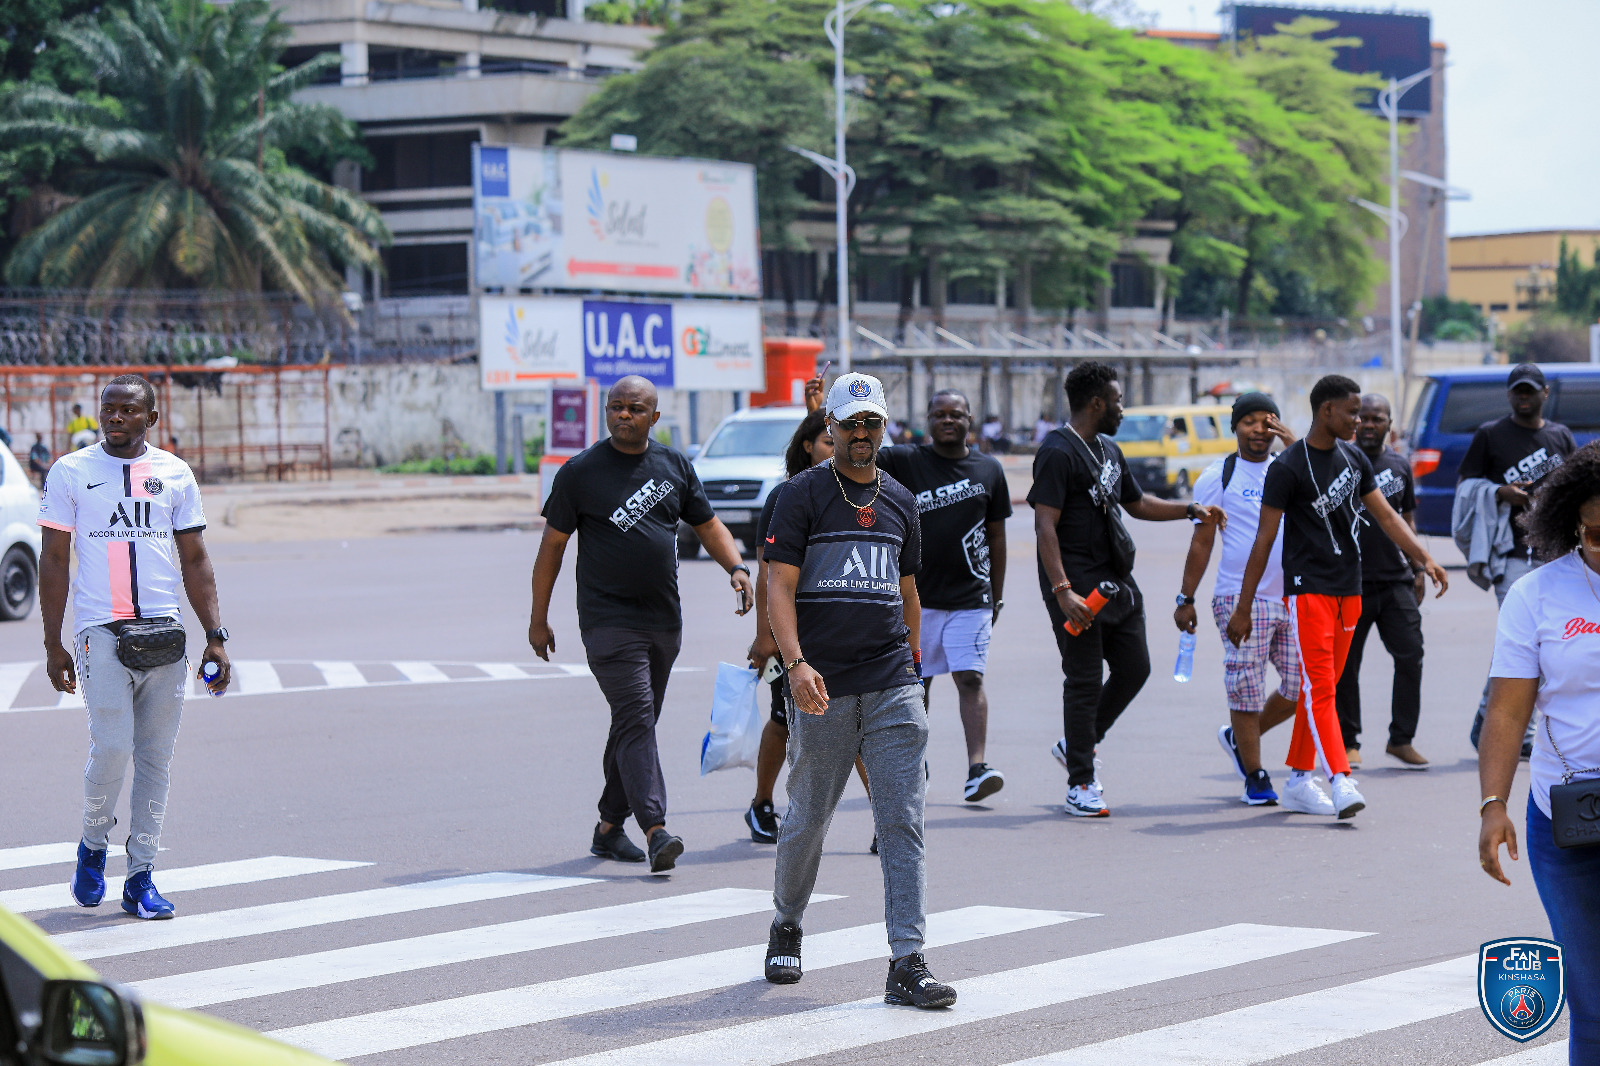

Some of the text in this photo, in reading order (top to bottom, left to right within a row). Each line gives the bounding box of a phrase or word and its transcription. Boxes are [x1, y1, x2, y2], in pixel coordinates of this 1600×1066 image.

[585, 311, 671, 358] U.A.C.
[608, 506, 628, 526] ICI
[617, 480, 675, 533] KINSHASA
[89, 530, 115, 538] ACCOR
[117, 530, 135, 538] LIVE
[816, 580, 848, 588] ACCOR
[850, 580, 870, 589] LIVE
